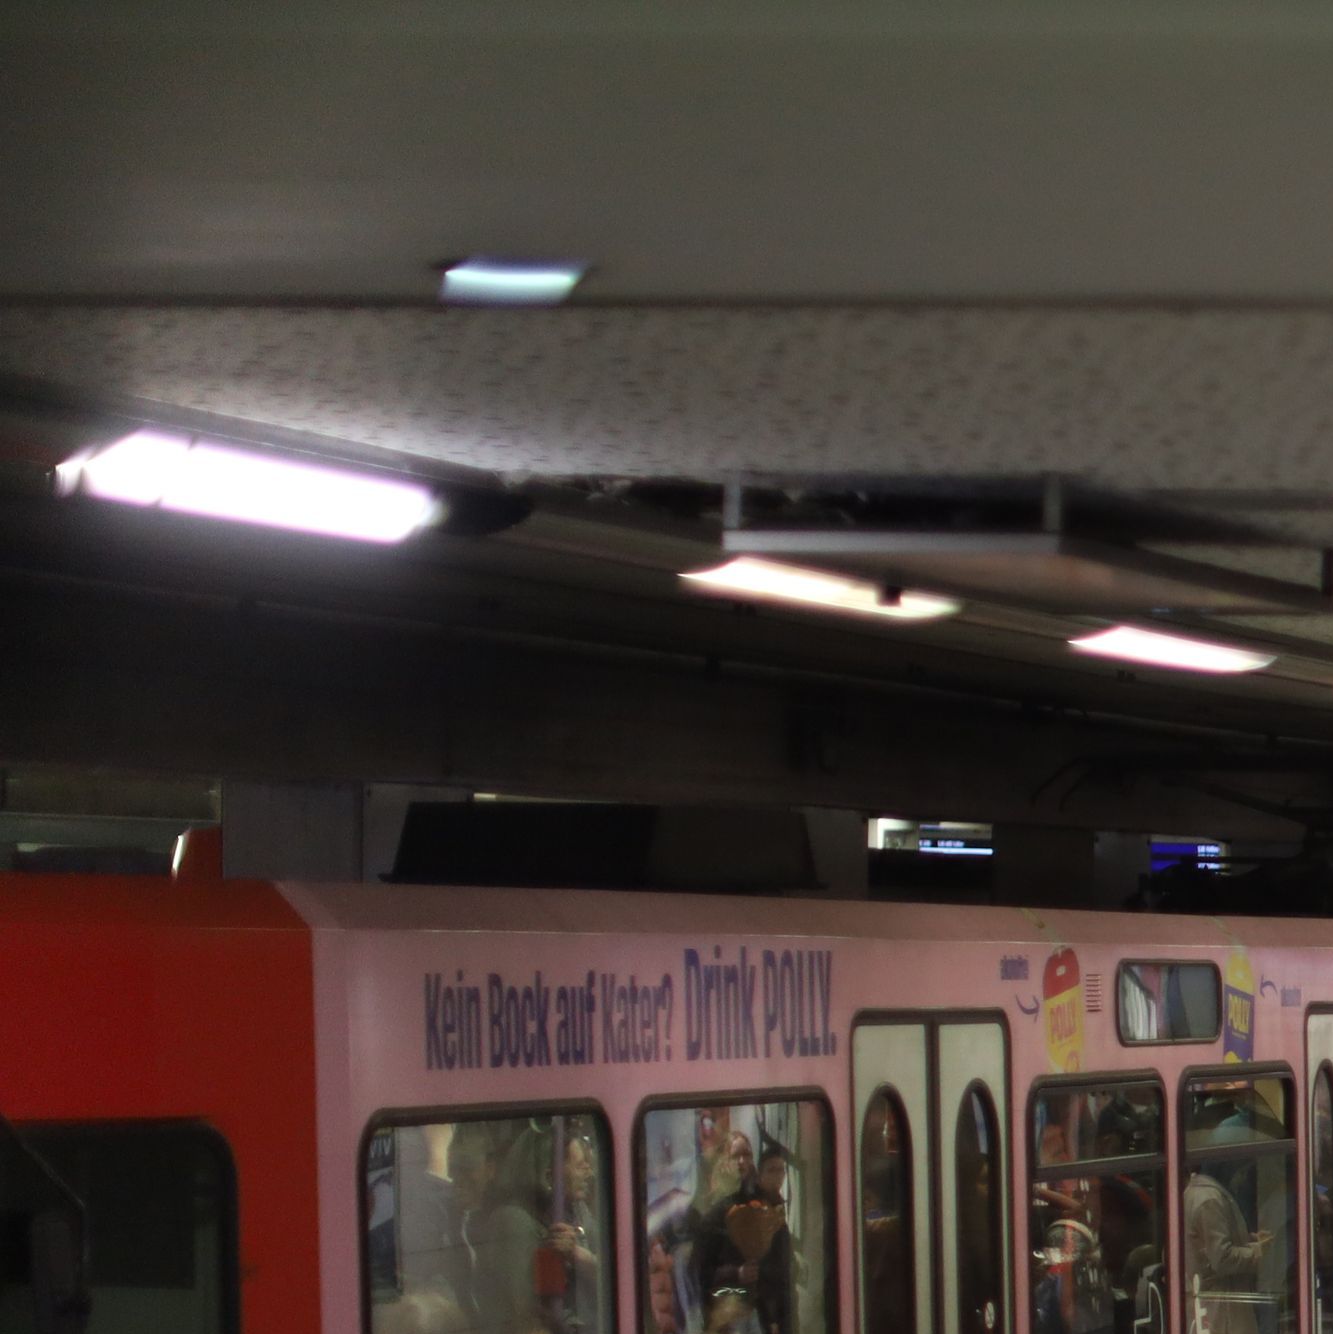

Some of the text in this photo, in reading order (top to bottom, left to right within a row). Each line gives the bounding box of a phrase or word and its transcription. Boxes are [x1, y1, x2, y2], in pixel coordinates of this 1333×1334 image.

[424, 945, 837, 1069] Kein Bock auf Kater? Drink POLLY.
[1049, 999, 1076, 1043] POLLY
[1227, 994, 1250, 1033] POLLY
